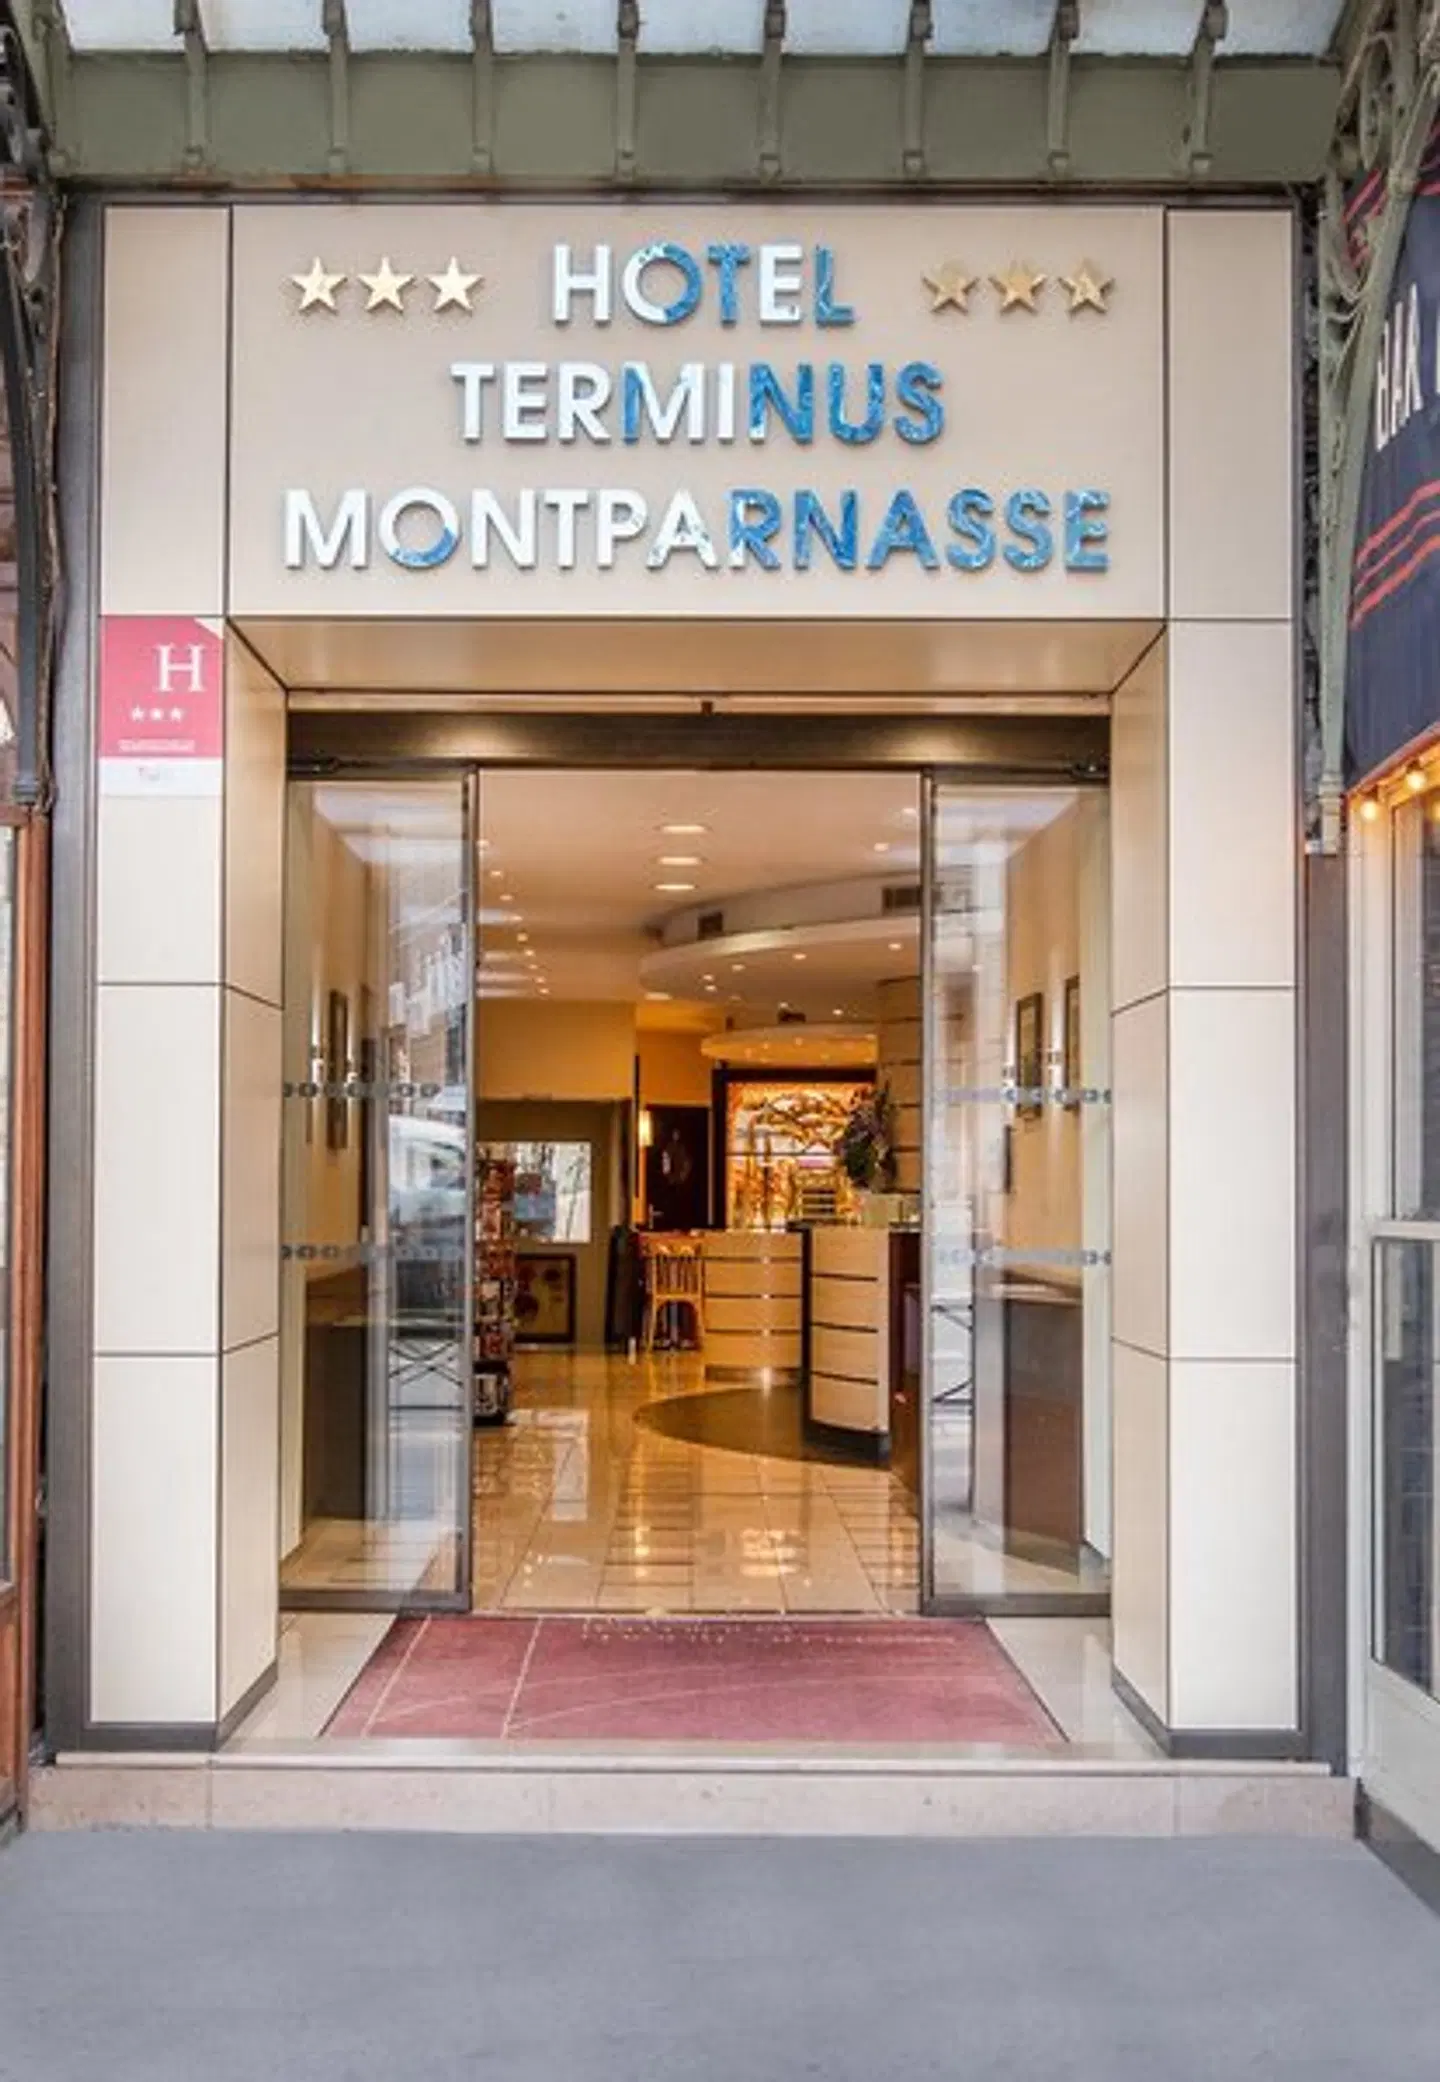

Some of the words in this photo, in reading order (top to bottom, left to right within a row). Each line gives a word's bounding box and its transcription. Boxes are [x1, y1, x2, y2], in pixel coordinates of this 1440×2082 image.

[552, 241, 855, 326] HOTEL
[450, 360, 945, 445] TERMINUS
[283, 487, 1111, 574] MONTPARNASSE
[155, 642, 207, 693] H
